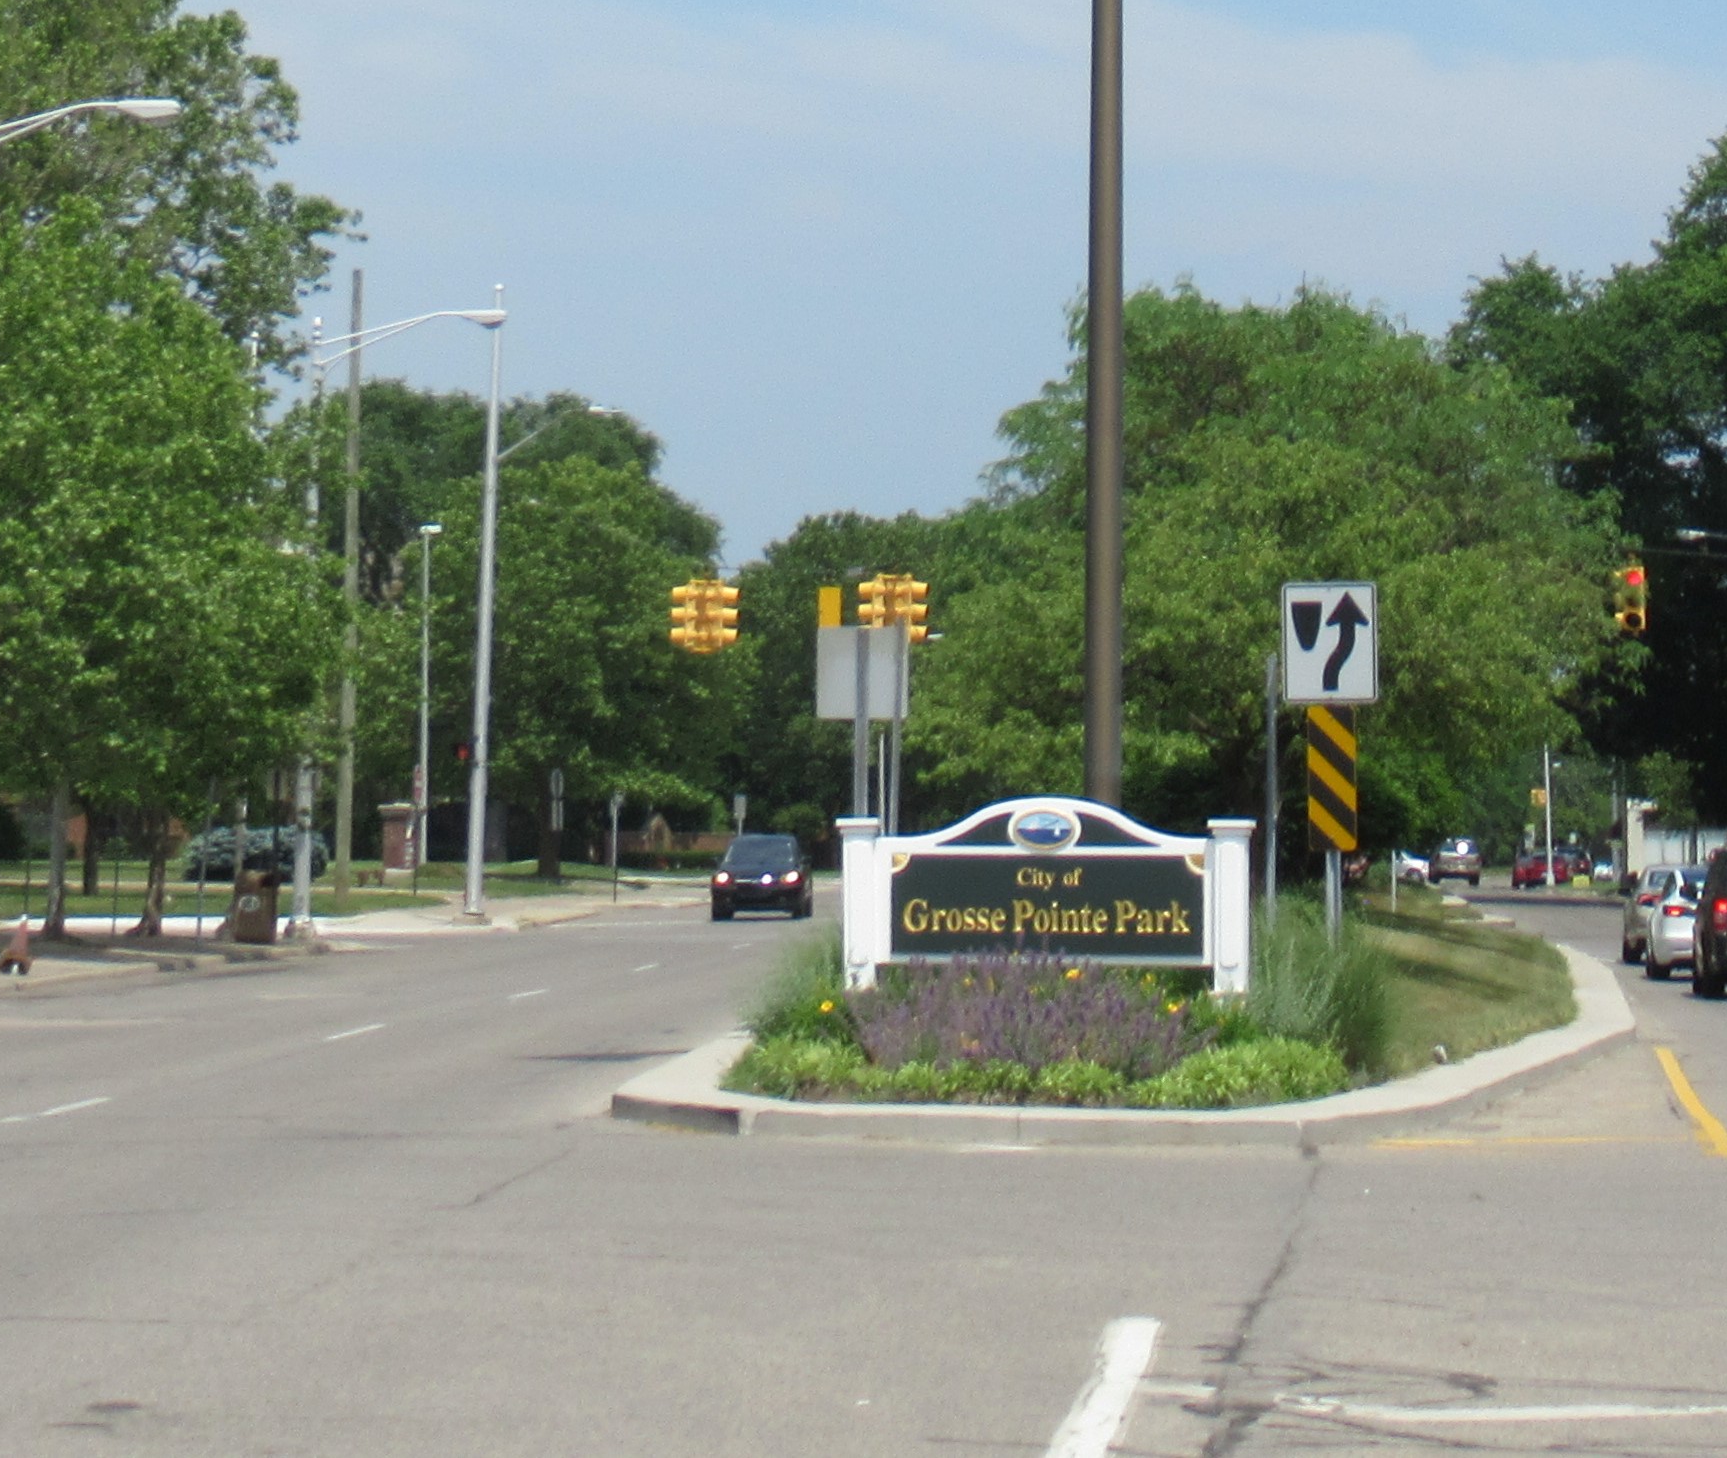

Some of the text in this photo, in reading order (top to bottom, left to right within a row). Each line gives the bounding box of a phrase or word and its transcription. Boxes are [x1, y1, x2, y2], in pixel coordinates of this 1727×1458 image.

[1016, 867, 1083, 889] City of
[902, 898, 1191, 934] Grosse Pointe Park
